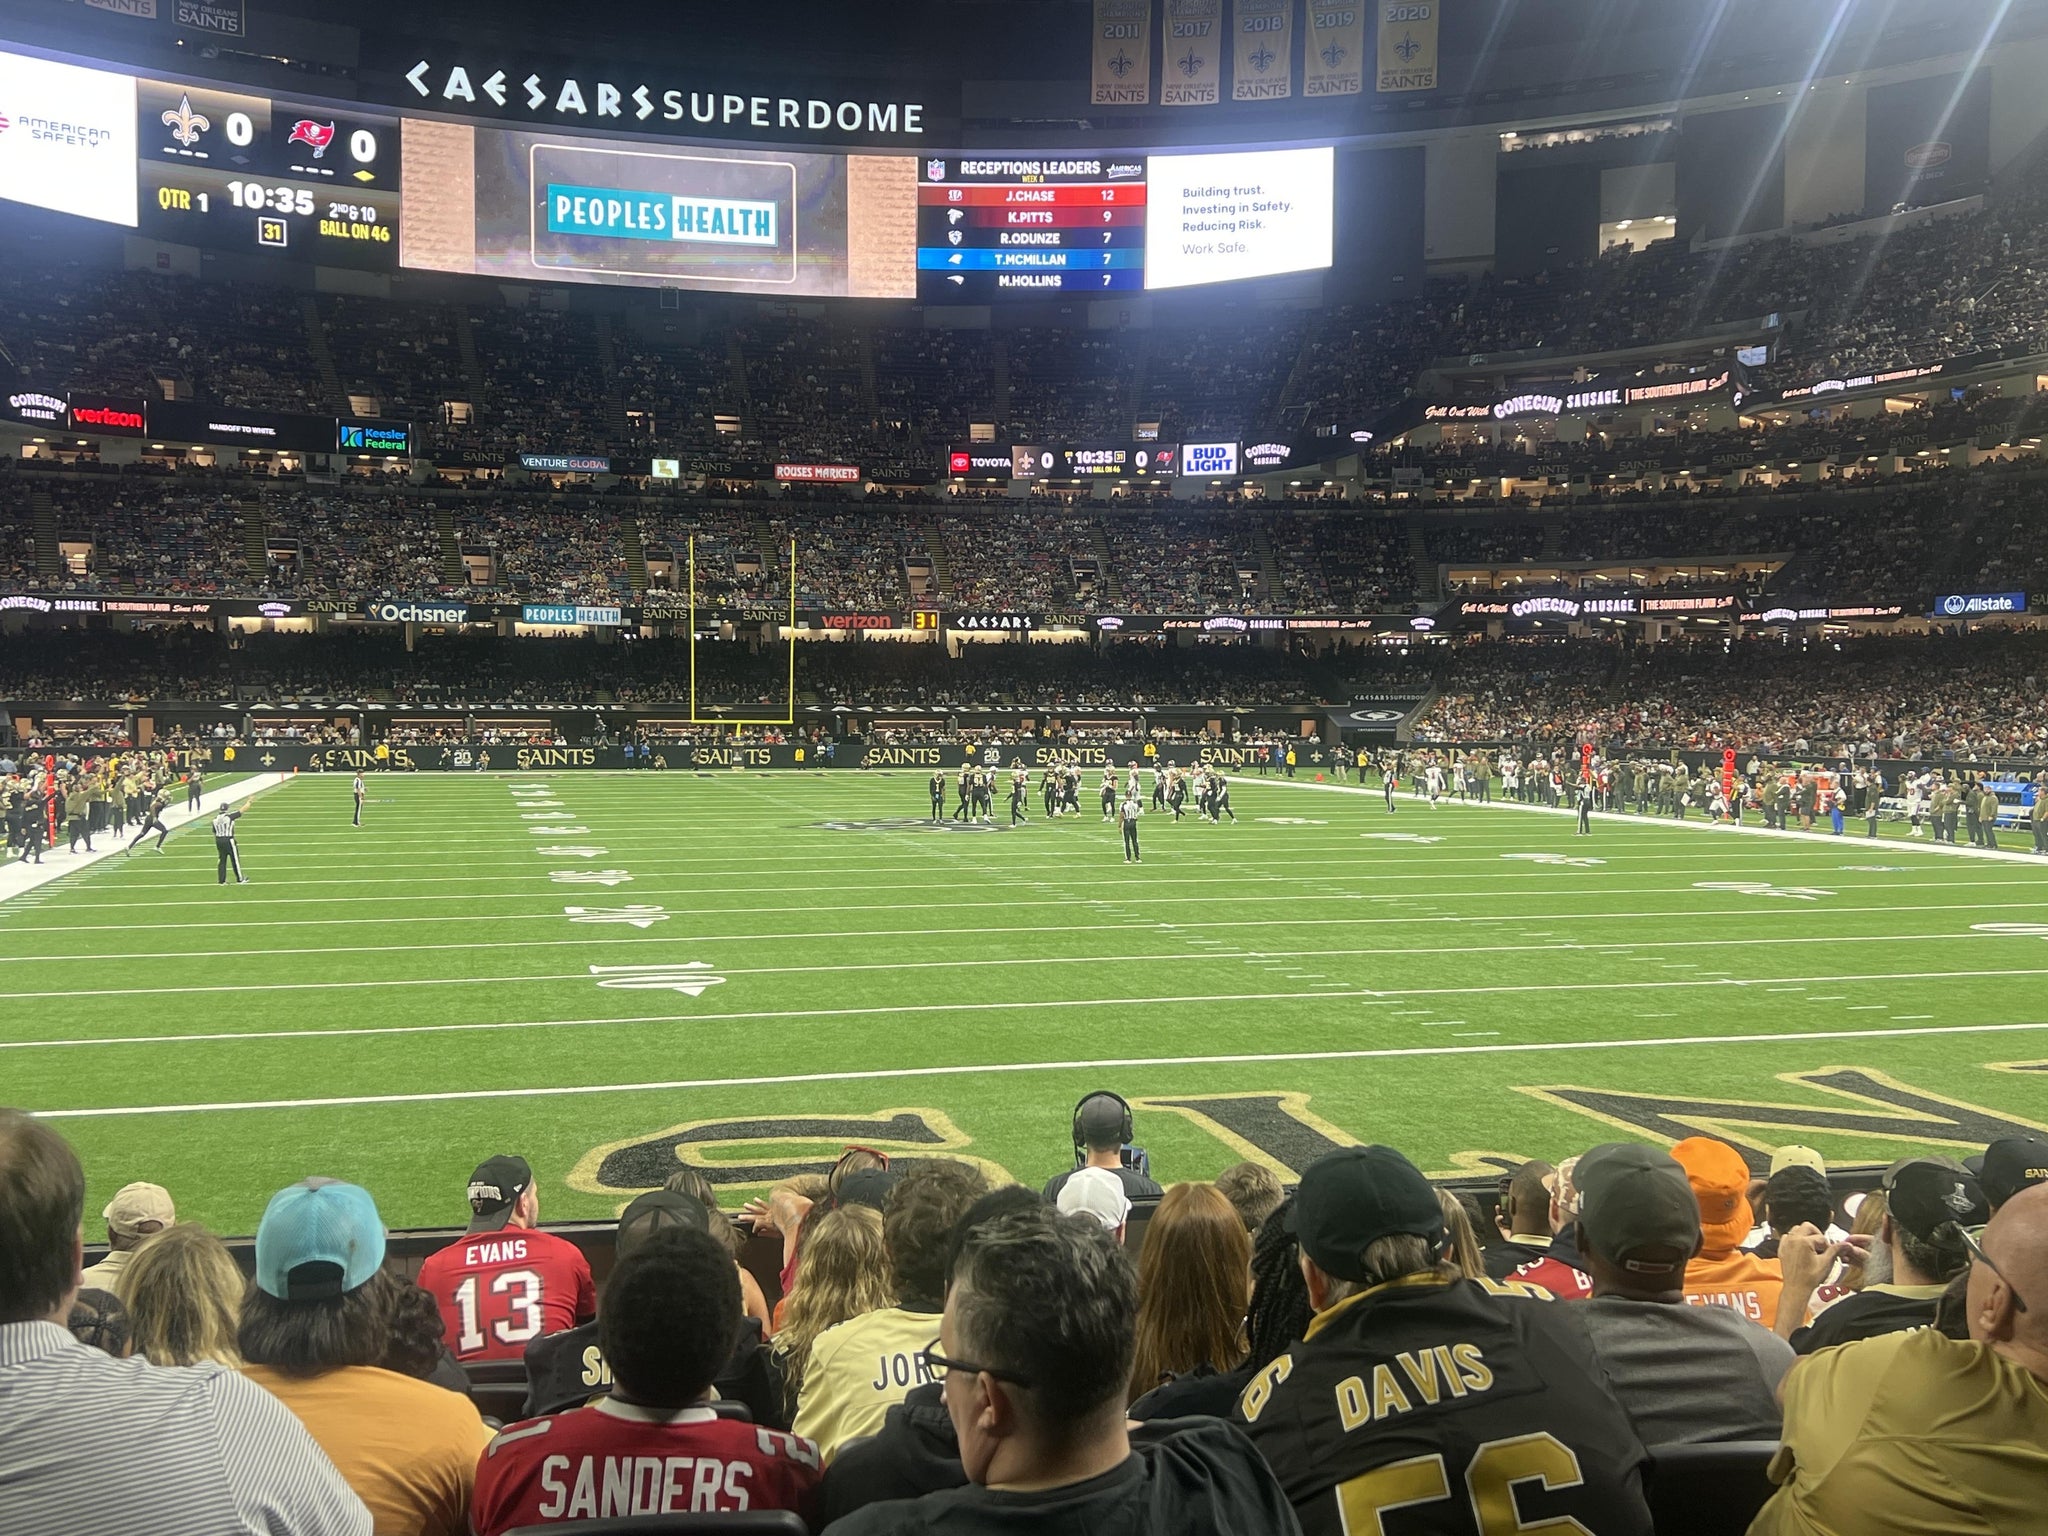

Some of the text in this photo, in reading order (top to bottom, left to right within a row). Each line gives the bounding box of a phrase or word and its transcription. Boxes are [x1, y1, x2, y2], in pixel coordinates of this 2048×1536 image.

[179, 8, 238, 32] SAINTS
[1315, 11, 1355, 28] 2019
[1386, 5, 1430, 23] 2020
[1104, 23, 1140, 39] 2011
[1173, 21, 1212, 38] 2017
[1243, 16, 1283, 32] 2018
[1308, 80, 1358, 95] SAINTS
[1381, 74, 1433, 89] SAINTS
[406, 60, 924, 134] CAESARS SUPERDOME
[1096, 90, 1145, 102] SAINTS
[1165, 90, 1215, 103] SAINTS
[1236, 84, 1286, 98] SAINTS
[19, 116, 110, 140] AMERICAN
[226, 112, 253, 146] 0
[32, 129, 99, 147] SAFETY
[350, 130, 376, 163] 0
[961, 161, 1040, 175] RECEPTIONS
[1043, 160, 1100, 174] LEADERS
[1022, 175, 1038, 183] WEEK
[227, 181, 315, 215] 10:35
[1006, 190, 1114, 201] J.CHASE 12
[1183, 185, 1265, 198] Building trust.
[158, 187, 208, 212] QTR 1
[361, 206, 376, 222] 10
[1183, 201, 1294, 215] Investing in Safety.
[556, 195, 771, 238] PEOPLES HEALTH
[1008, 211, 1112, 223] K.PITTS 9
[264, 223, 281, 240] 31
[320, 220, 390, 242] BALL ON 46
[1183, 219, 1266, 232] Reducing Risk.
[1000, 232, 1112, 244] R.ODUNZE 7
[1182, 242, 1249, 254] Work Safe.
[995, 253, 1111, 265] T.MCMILLAN 7
[999, 275, 1111, 287] M.HOLLINS 7
[10, 393, 66, 413] CONECUH
[1566, 389, 1622, 409] SAUSAGE.
[1425, 395, 1563, 419] Grill Out With CONECUH
[73, 407, 142, 427] verizon
[209, 422, 241, 433] HANDOFF
[365, 428, 406, 440] Keesler
[365, 438, 405, 450] Federal
[1890, 434, 1928, 448] SAINTS
[463, 452, 505, 463] SAINTS
[1075, 450, 1113, 464] 10:35
[1193, 447, 1226, 459] BUD
[1245, 443, 1291, 458] CONECUH
[1802, 444, 1842, 457] SAINTS
[522, 457, 609, 469] VENTURE GLOBAL
[970, 457, 1012, 468] TOYOTA
[1041, 452, 1054, 469] 0
[1135, 451, 1148, 467] 0
[1186, 459, 1232, 472] LIGHT
[1619, 459, 1661, 471] SAINTS
[1712, 453, 1754, 465] SAINTS
[691, 462, 731, 472] SAINTS
[776, 466, 858, 479] ROUSES MARKETS
[872, 468, 910, 479] SAINTS
[1436, 467, 1477, 478] SAINTS
[1528, 464, 1569, 475] SAINTS
[54, 601, 100, 611] SAUSAGE.
[307, 601, 357, 612] SAINTS
[381, 604, 467, 622] Ochsner
[1512, 597, 1580, 617] CONECUH
[1584, 600, 1637, 612] SAUSAGE.
[526, 607, 619, 622] PEOPLES HEALTH
[643, 609, 687, 619] SAINTS
[743, 611, 786, 621] SAINTS
[822, 612, 891, 628] verizon
[916, 612, 936, 628] 31
[1044, 615, 1086, 624] SAINTS
[957, 616, 1032, 628] CAESARS
[1203, 617, 1247, 631] CONECUH
[422, 703, 627, 711] SUPERDOME
[977, 705, 1158, 713] SUPERDOME
[517, 748, 596, 766] SAINTS
[869, 747, 941, 765] SAINTS
[1036, 748, 1106, 764] SAINTS
[1200, 747, 1270, 764] SAINT
[465, 1239, 527, 1266] EVANS
[454, 1269, 544, 1354] 13
[872, 1351, 933, 1391] JOR
[1335, 1342, 1494, 1432] DAVIS
[539, 1454, 753, 1519] SANDERS
